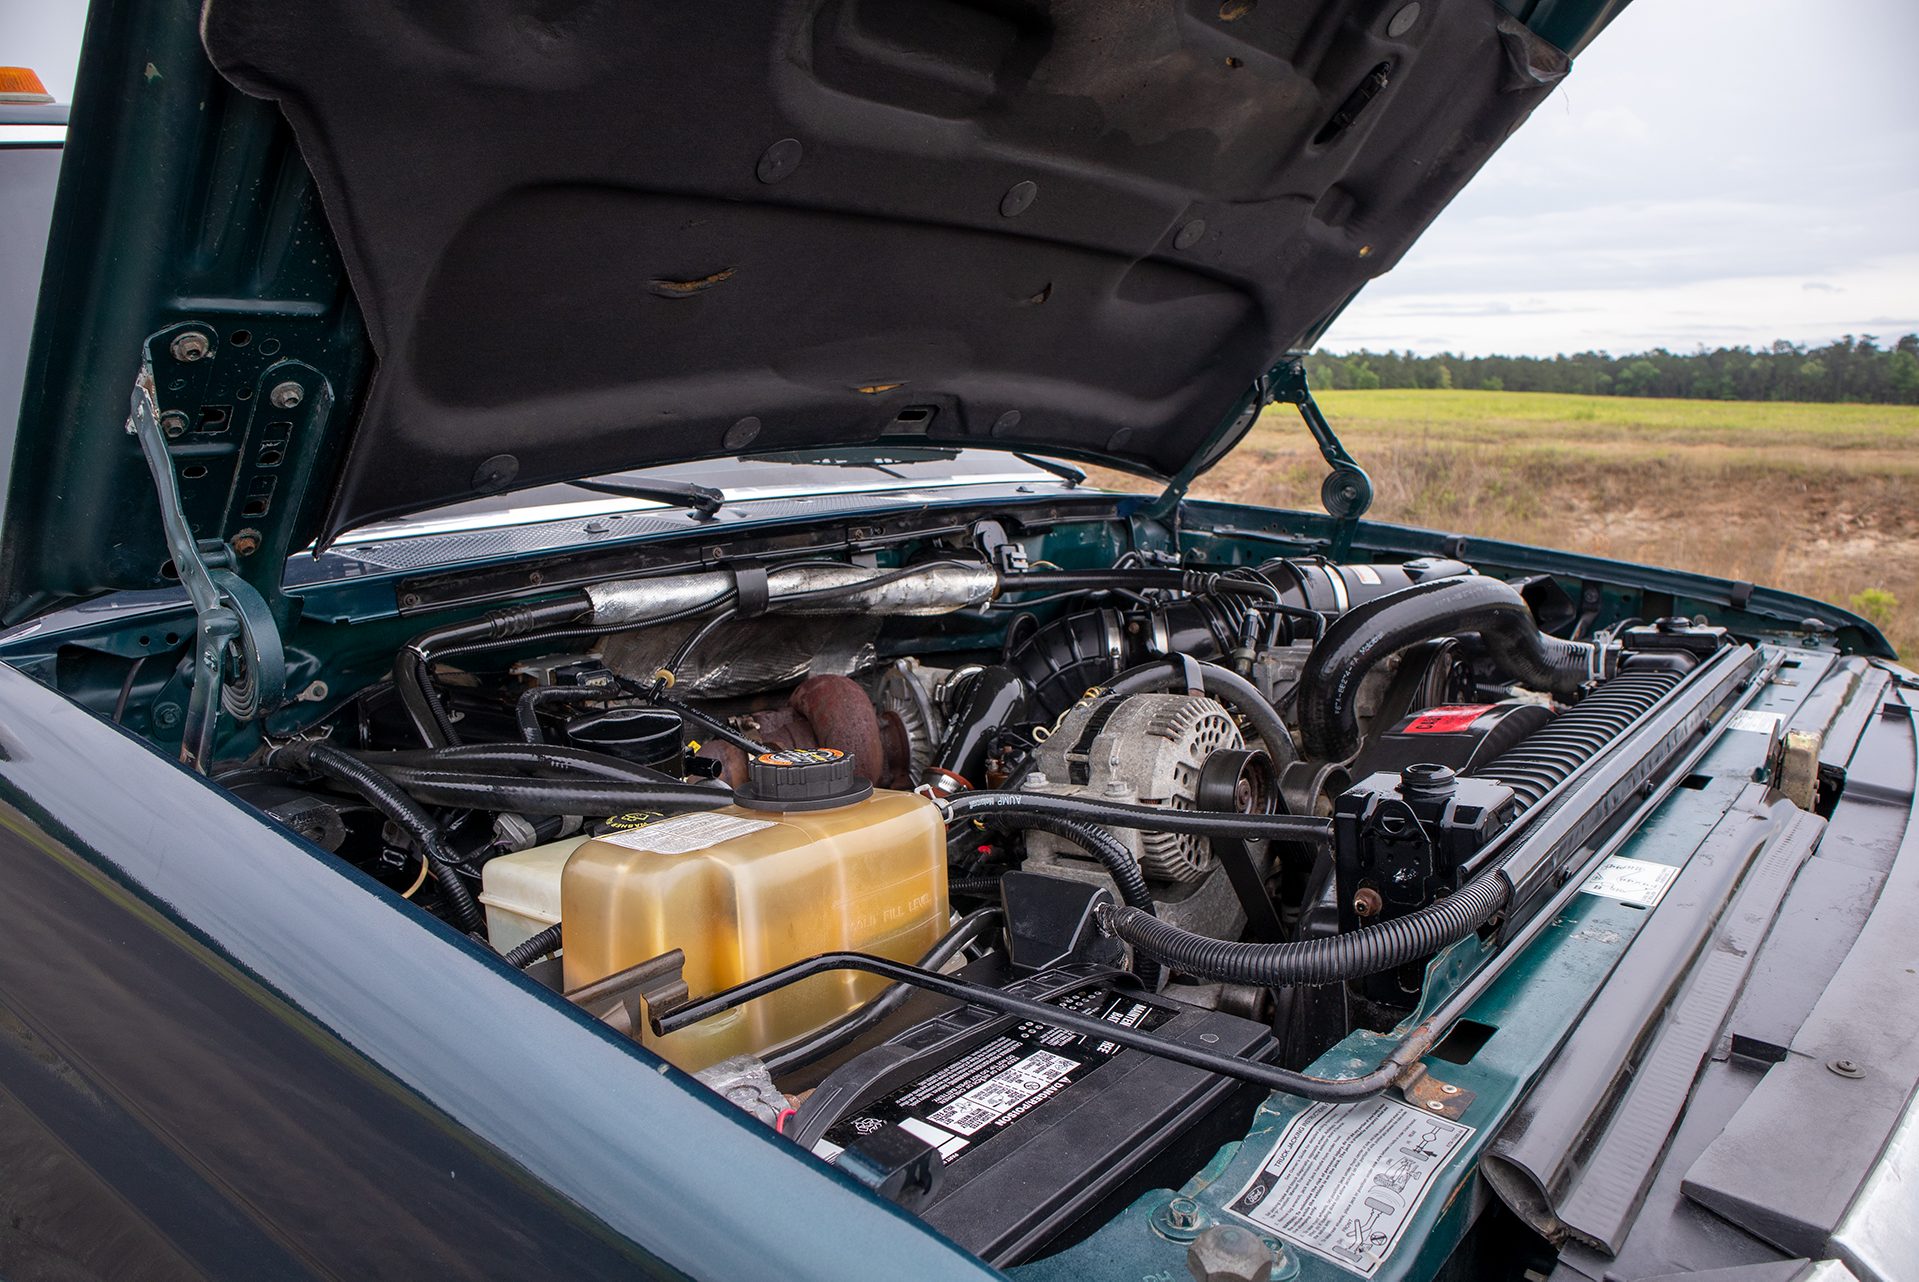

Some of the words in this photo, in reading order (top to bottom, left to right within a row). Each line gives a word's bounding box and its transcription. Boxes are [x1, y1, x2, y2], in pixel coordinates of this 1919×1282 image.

[883, 905, 905, 922] FILL
[908, 893, 932, 912] LEVEL
[1096, 1040, 1115, 1054] REE
[992, 1082, 1064, 1126] DANGER/POISON
[1286, 1126, 1305, 1149] JACKING
[1301, 1104, 1327, 1127] INSTRUCTIONS
[1340, 1218, 1354, 1232] FRONT
